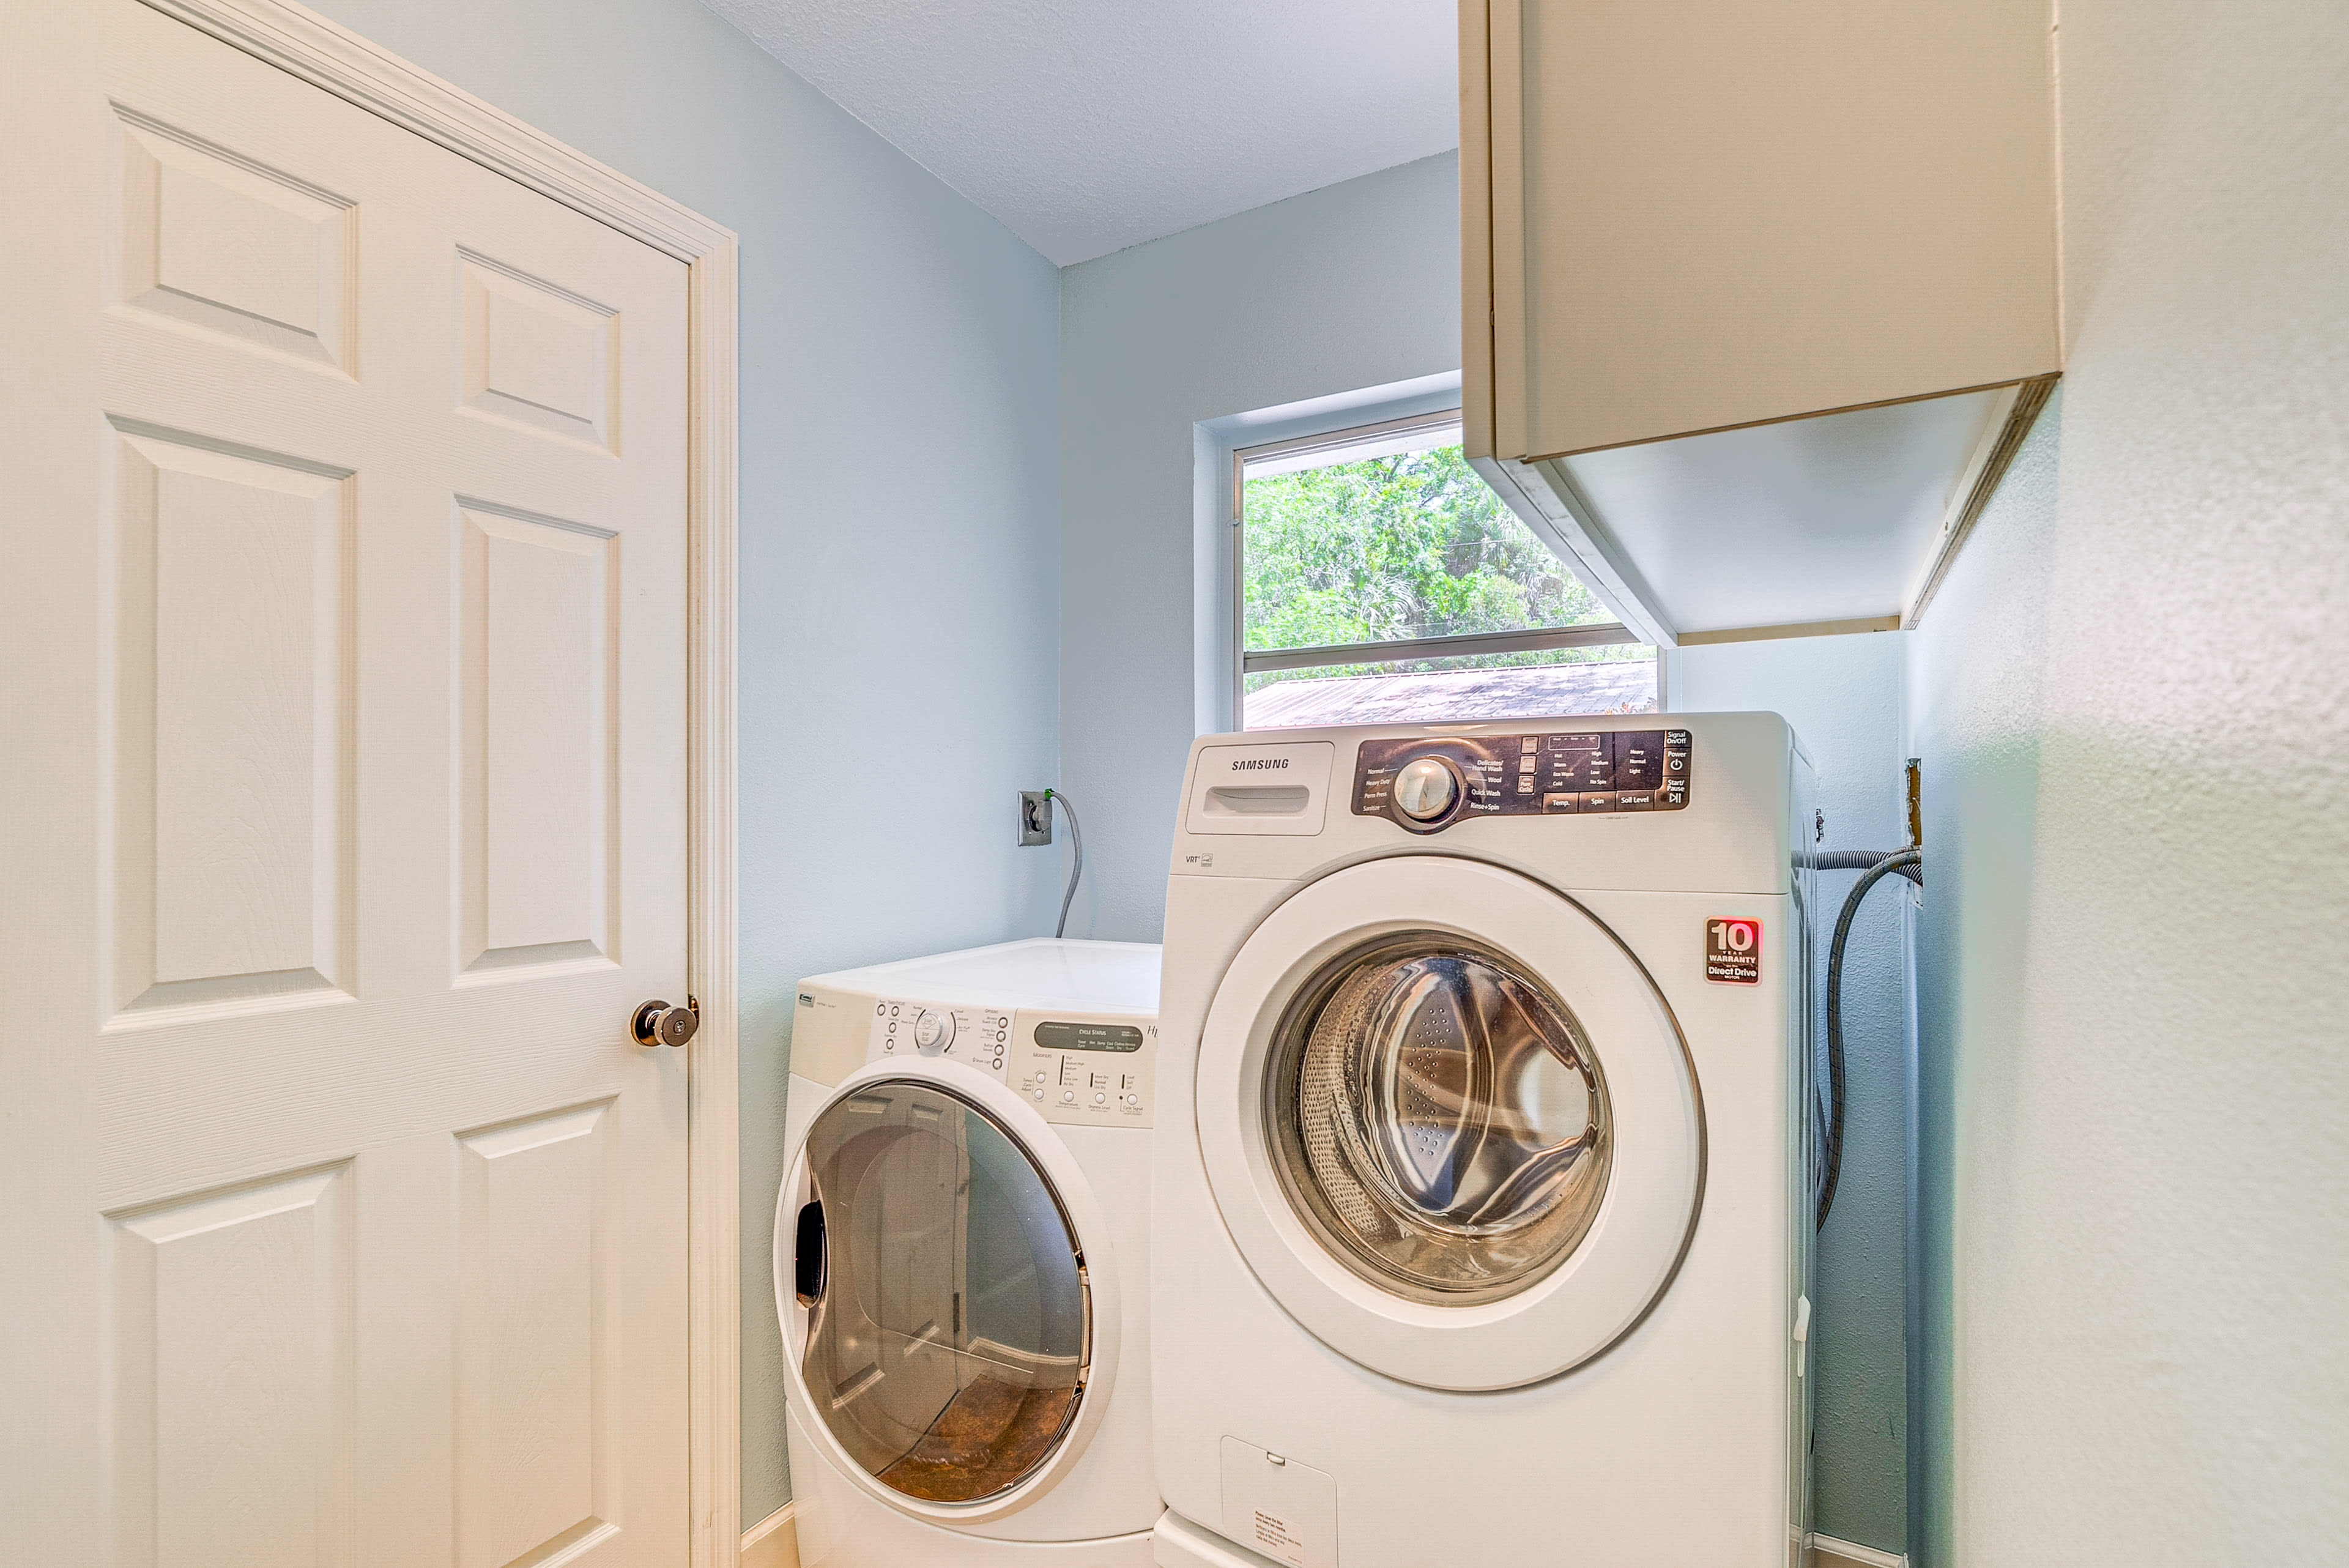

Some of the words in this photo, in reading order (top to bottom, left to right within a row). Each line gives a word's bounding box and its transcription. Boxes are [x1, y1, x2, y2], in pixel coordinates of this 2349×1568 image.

[1232, 759, 1290, 771] SAMSUNG
[1470, 802, 1500, 811] Rinse+Spin
[1553, 799, 1570, 808] Temp.
[1590, 798, 1605, 806] Spin
[1711, 922, 1754, 951] 10
[1709, 954, 1756, 964] WARRANTY
[1708, 967, 1734, 975] Direct
[1734, 968, 1757, 977] Drive
